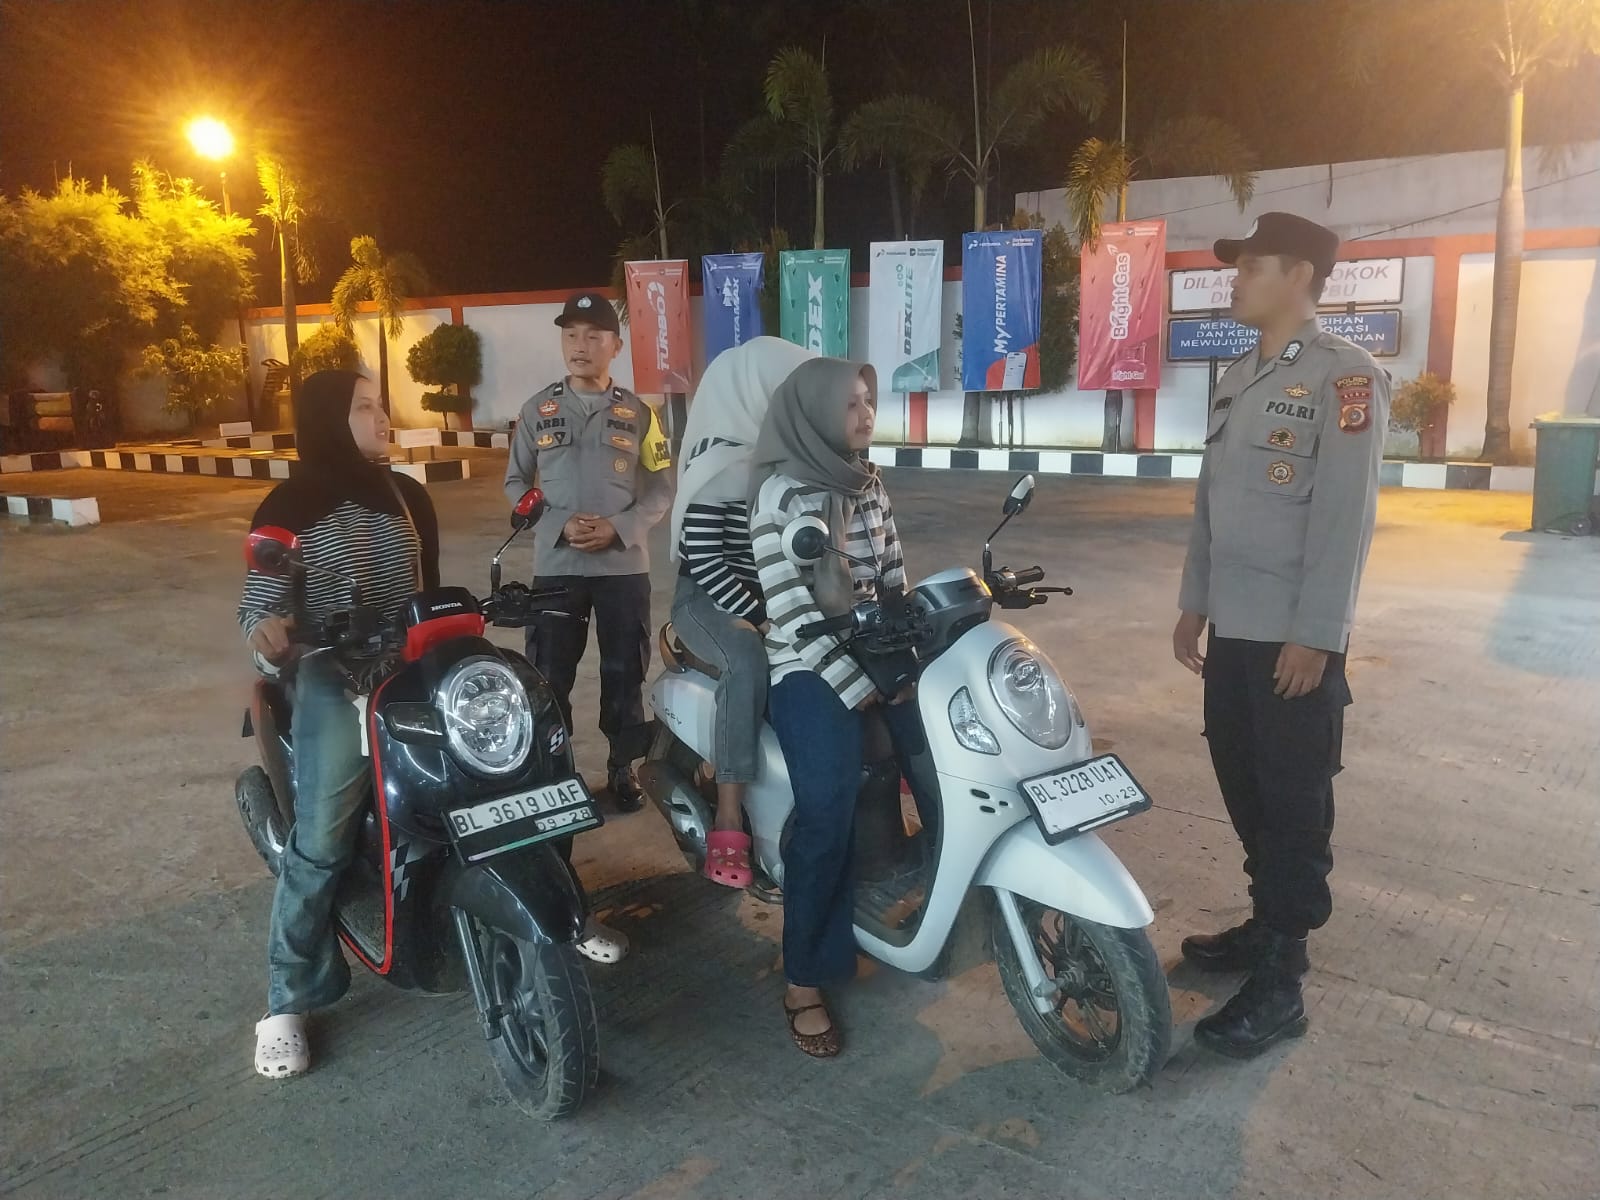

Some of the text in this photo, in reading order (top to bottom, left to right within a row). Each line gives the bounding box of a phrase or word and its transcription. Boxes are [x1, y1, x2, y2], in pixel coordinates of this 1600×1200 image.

[904, 266, 913, 355] DEXLITE
[656, 296, 670, 370] TURBO
[1180, 338, 1257, 348] MEWUJUDK
[1196, 330, 1223, 338] DAN
[1228, 328, 1262, 337] KEIN
[1265, 401, 1316, 421] POLRI
[536, 417, 566, 432] ARBI
[431, 601, 463, 612] HONDA
[1031, 761, 1122, 804] BL 3228 UAT
[453, 783, 580, 835] BL 3619 UAF
